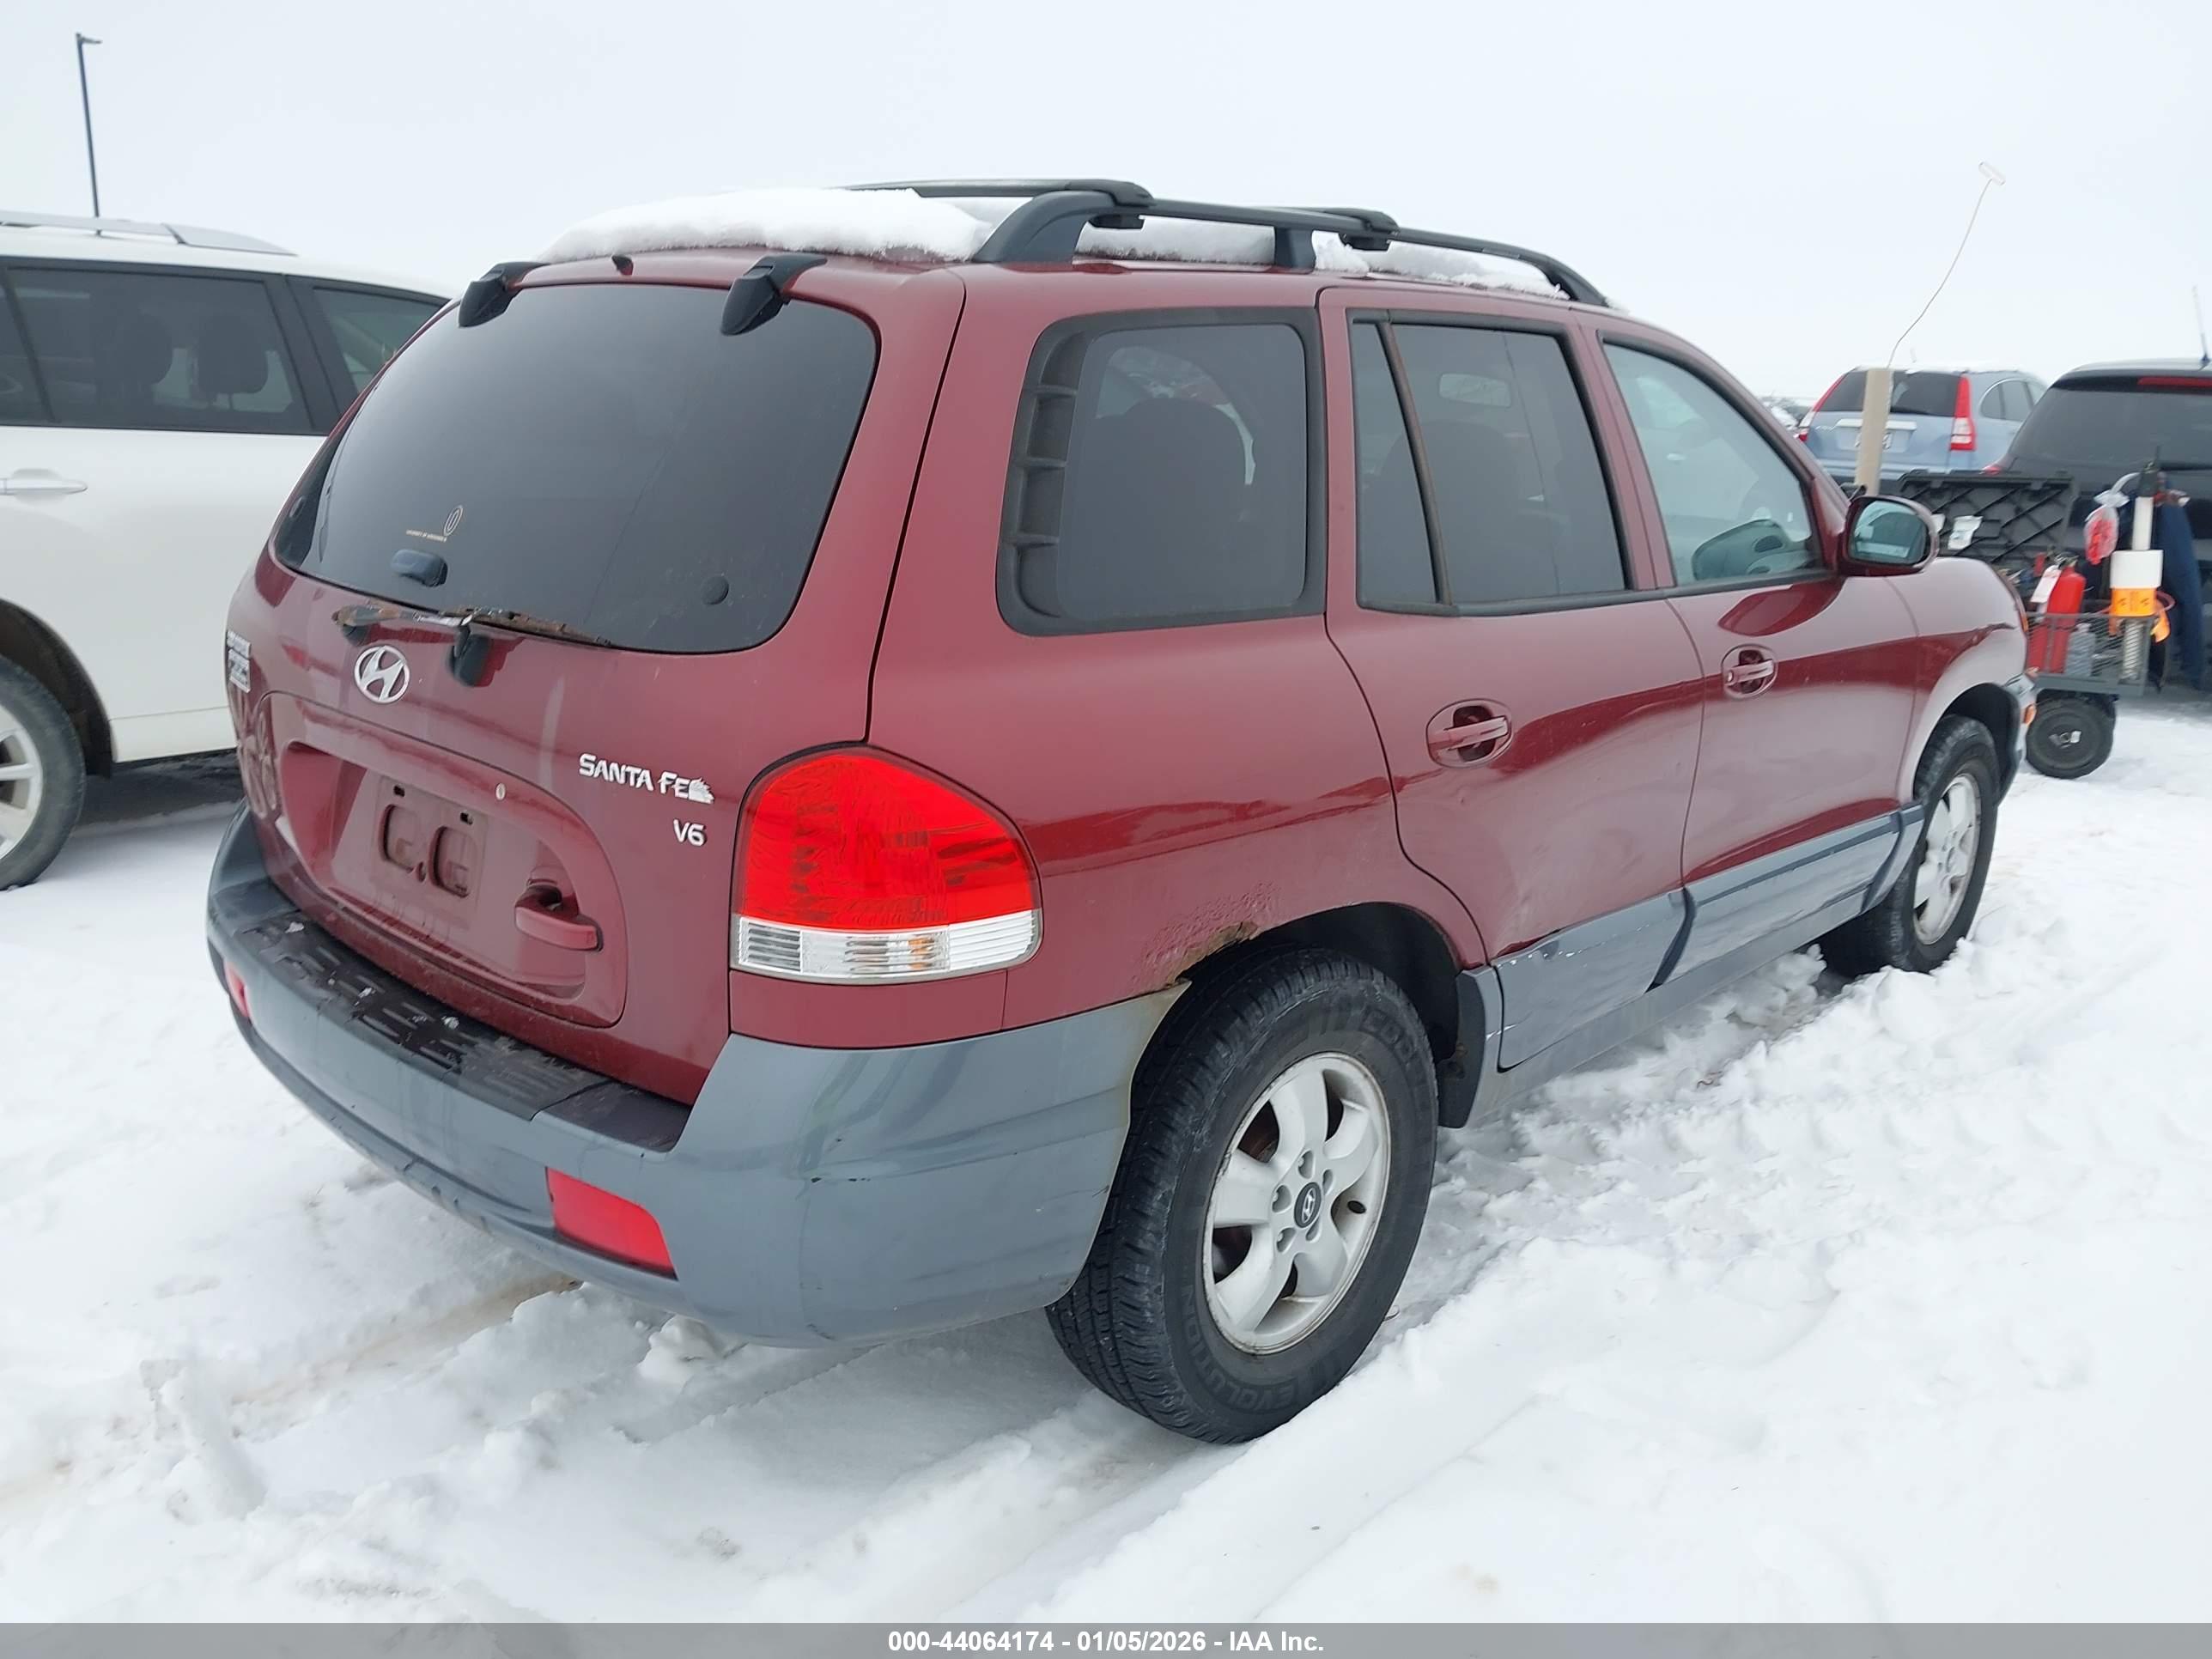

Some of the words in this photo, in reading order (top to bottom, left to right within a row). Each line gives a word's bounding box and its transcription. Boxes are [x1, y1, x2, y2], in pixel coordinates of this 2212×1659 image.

[579, 753, 654, 791] SANTA
[658, 771, 690, 799] FE
[673, 819, 705, 847] V6
[1180, 1283, 1297, 1412] EVOLUTION
